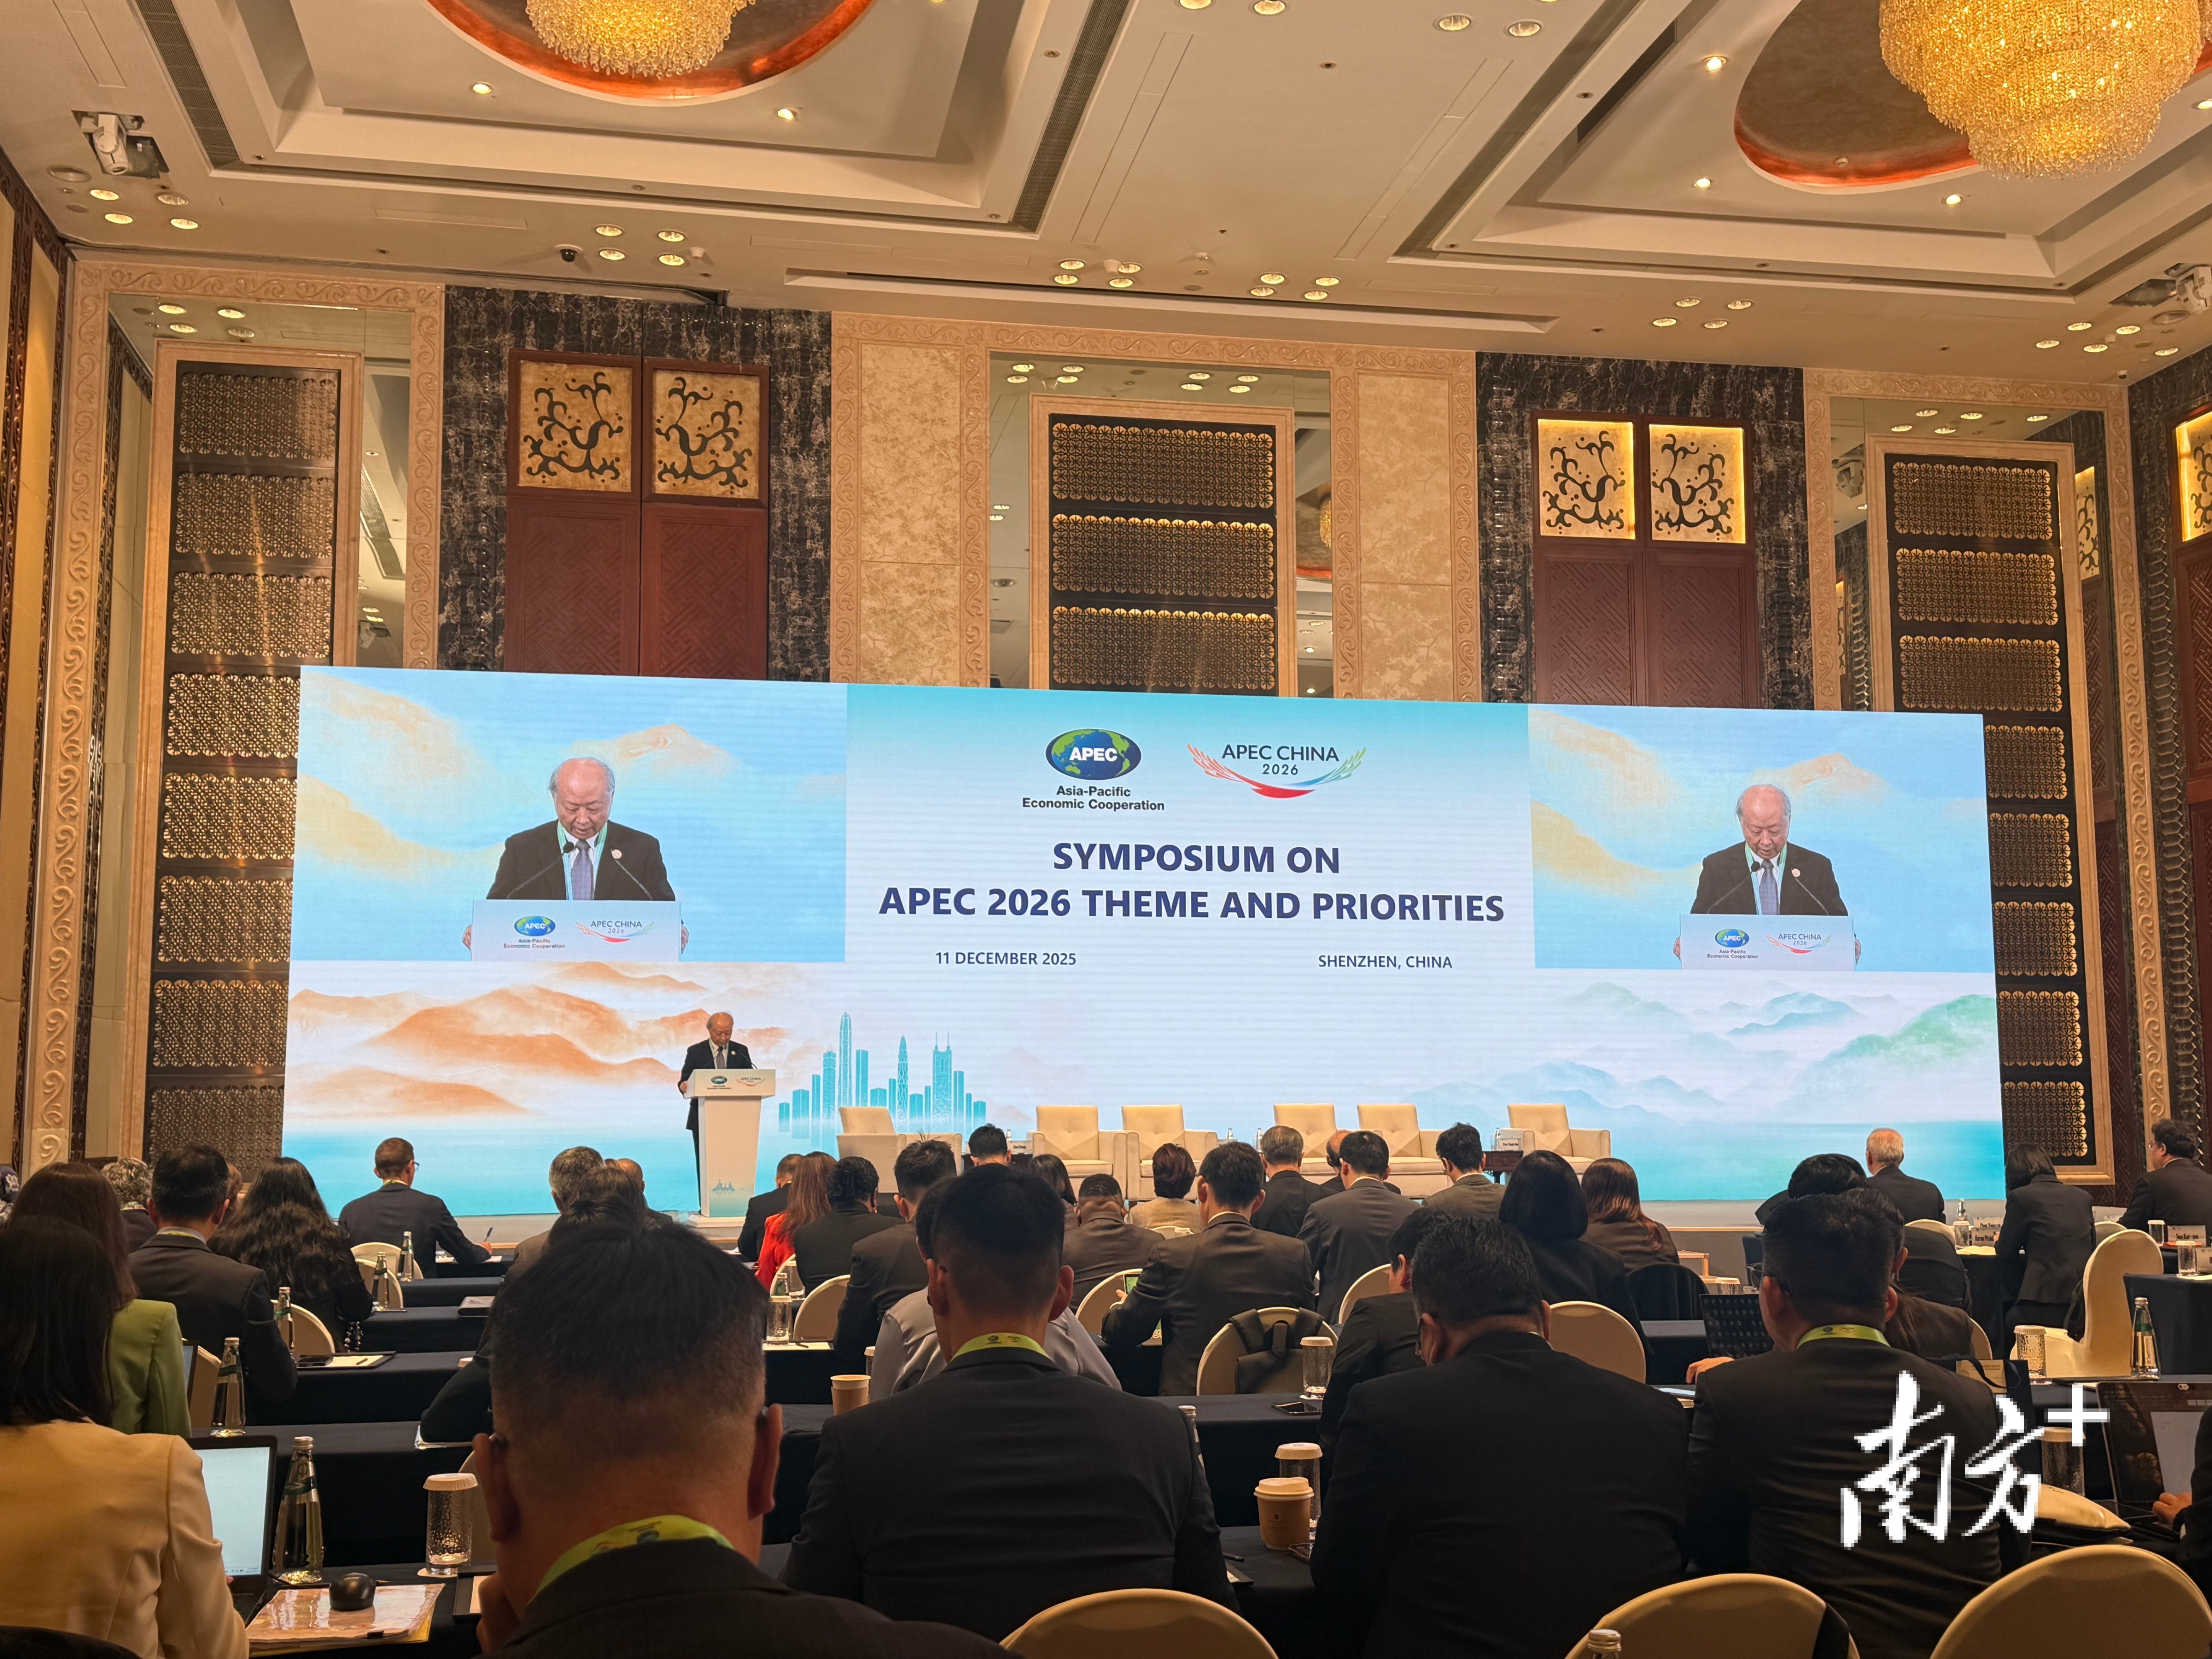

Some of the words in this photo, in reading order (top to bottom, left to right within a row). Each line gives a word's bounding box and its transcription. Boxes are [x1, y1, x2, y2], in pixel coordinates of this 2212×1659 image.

[1069, 747, 1118, 762] APEC
[1222, 744, 1272, 760] APEC
[1277, 746, 1339, 761] CHINA
[1262, 764, 1298, 775] 2026
[1056, 785, 1131, 797] Asia-Pacific
[1022, 798, 1084, 809] Economic
[1088, 799, 1165, 812] Cooperation
[1053, 842, 1274, 873] SYMPOSIUM
[1287, 847, 1340, 873] ON
[878, 887, 975, 915] APEC
[988, 888, 1071, 916] 2026
[1082, 890, 1209, 918] THEME
[1220, 892, 1300, 919] AND
[1313, 893, 1504, 922] PRIORITIES
[936, 952, 949, 964] 11
[956, 952, 1038, 965] DECEMBER
[1042, 953, 1076, 966] 2025
[1319, 955, 1401, 970] SHENZHEN,
[1406, 956, 1453, 968] CHINA
